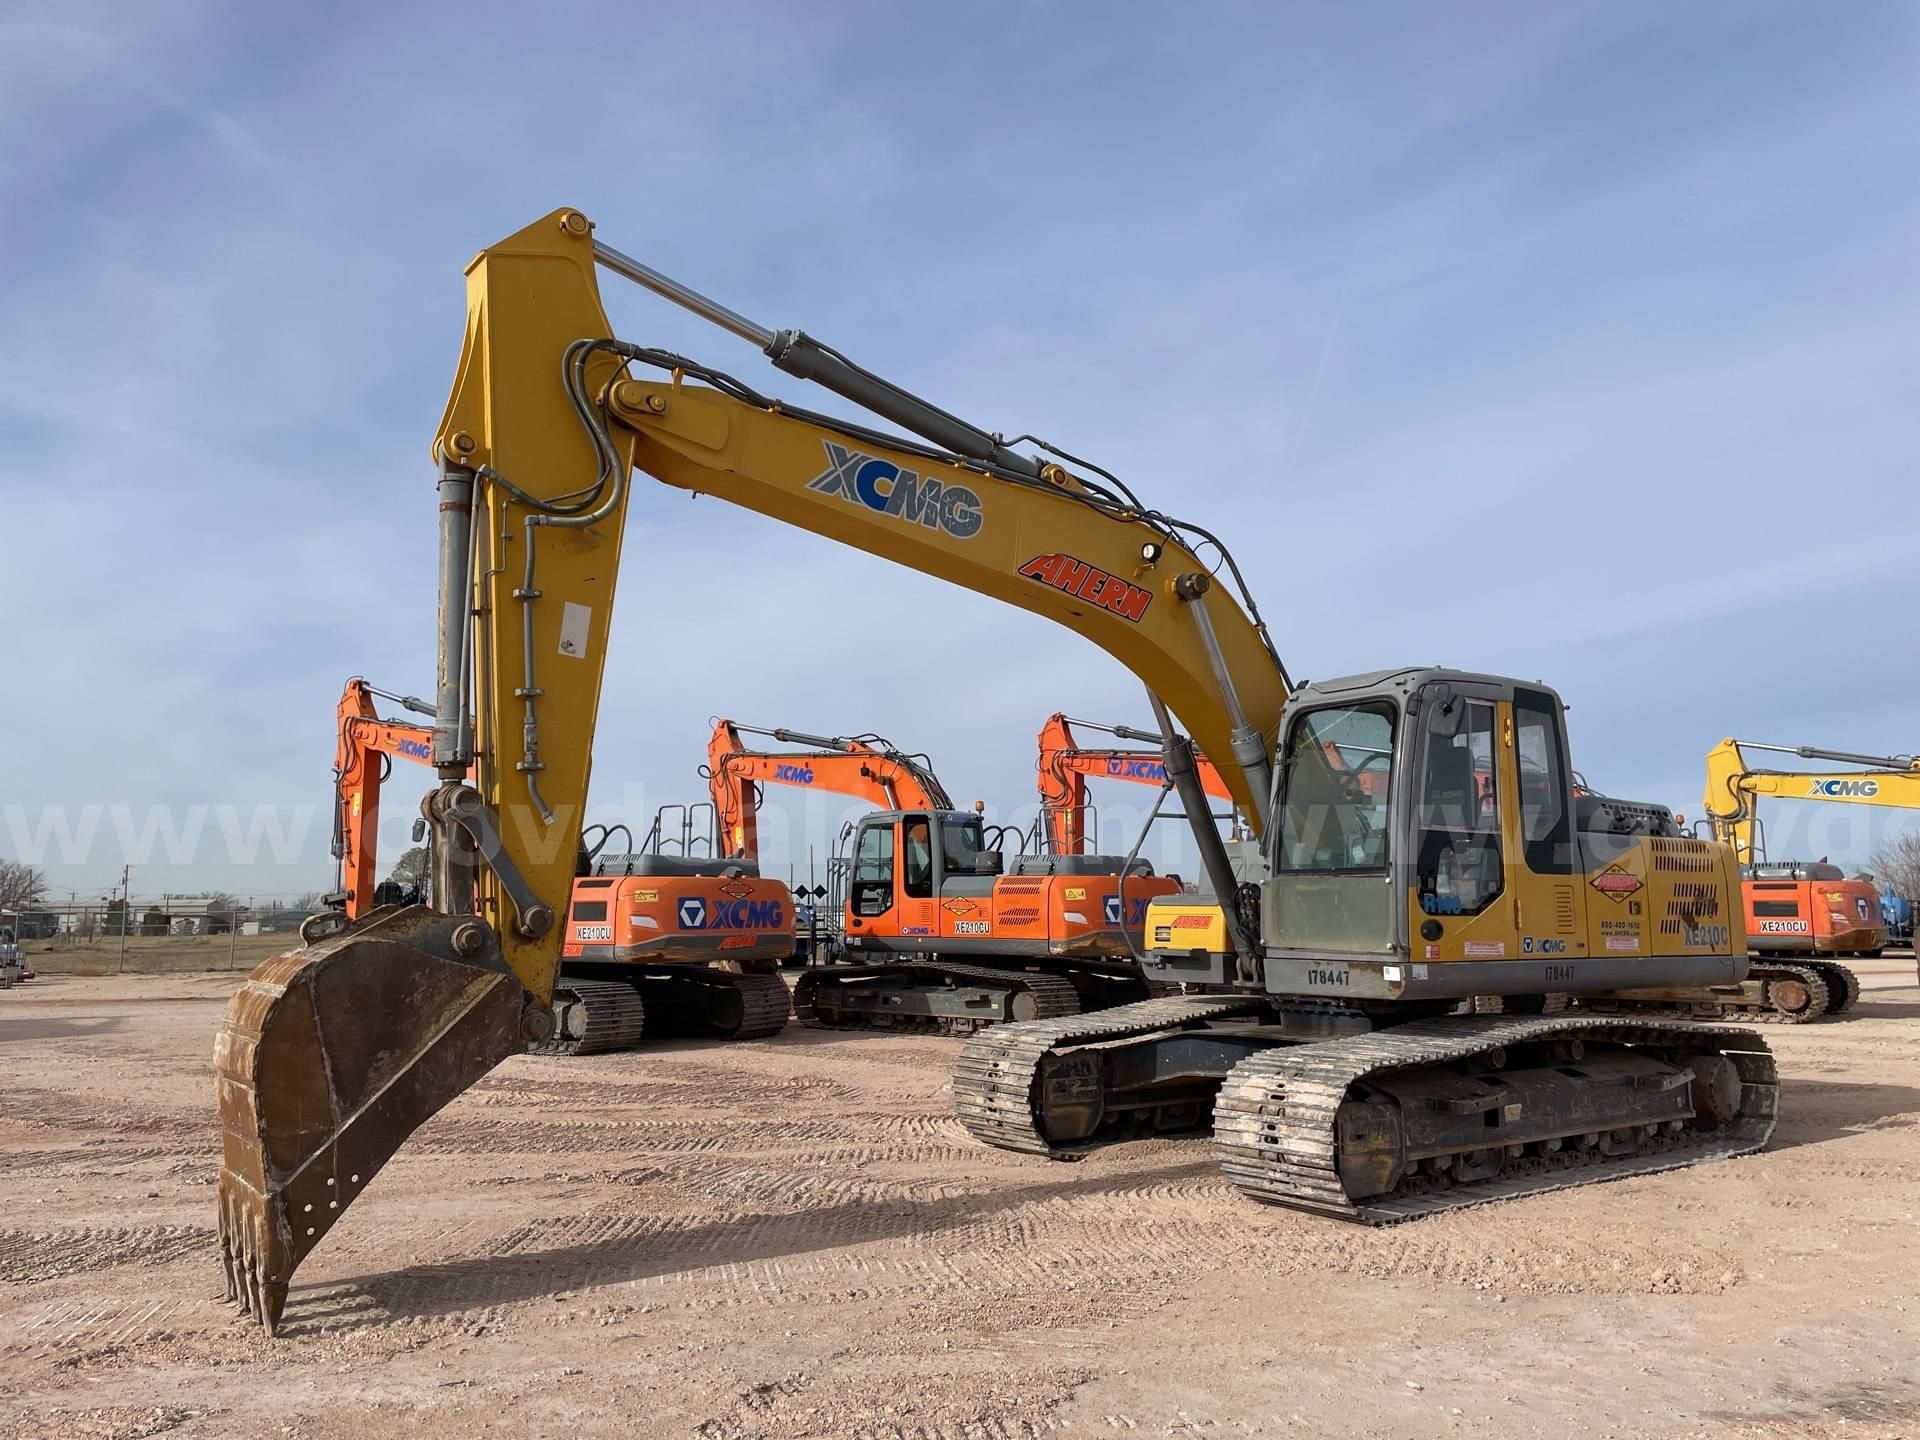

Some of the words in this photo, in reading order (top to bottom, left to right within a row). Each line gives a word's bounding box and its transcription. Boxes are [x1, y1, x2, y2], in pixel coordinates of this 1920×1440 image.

[804, 439, 984, 539] XCMG
[1018, 553, 1153, 623] AHERN
[396, 738, 431, 759] XCMG
[774, 764, 814, 784] XCMG
[1121, 761, 1165, 780] XCM
[1808, 779, 1879, 797] XCMG
[707, 900, 784, 929] XCMG
[576, 927, 612, 940] XE210CU
[954, 921, 991, 934] XE210CU
[1760, 920, 1808, 932] XE210CU
[1536, 939, 1566, 953] XCMG
[1308, 969, 1350, 985] 178447
